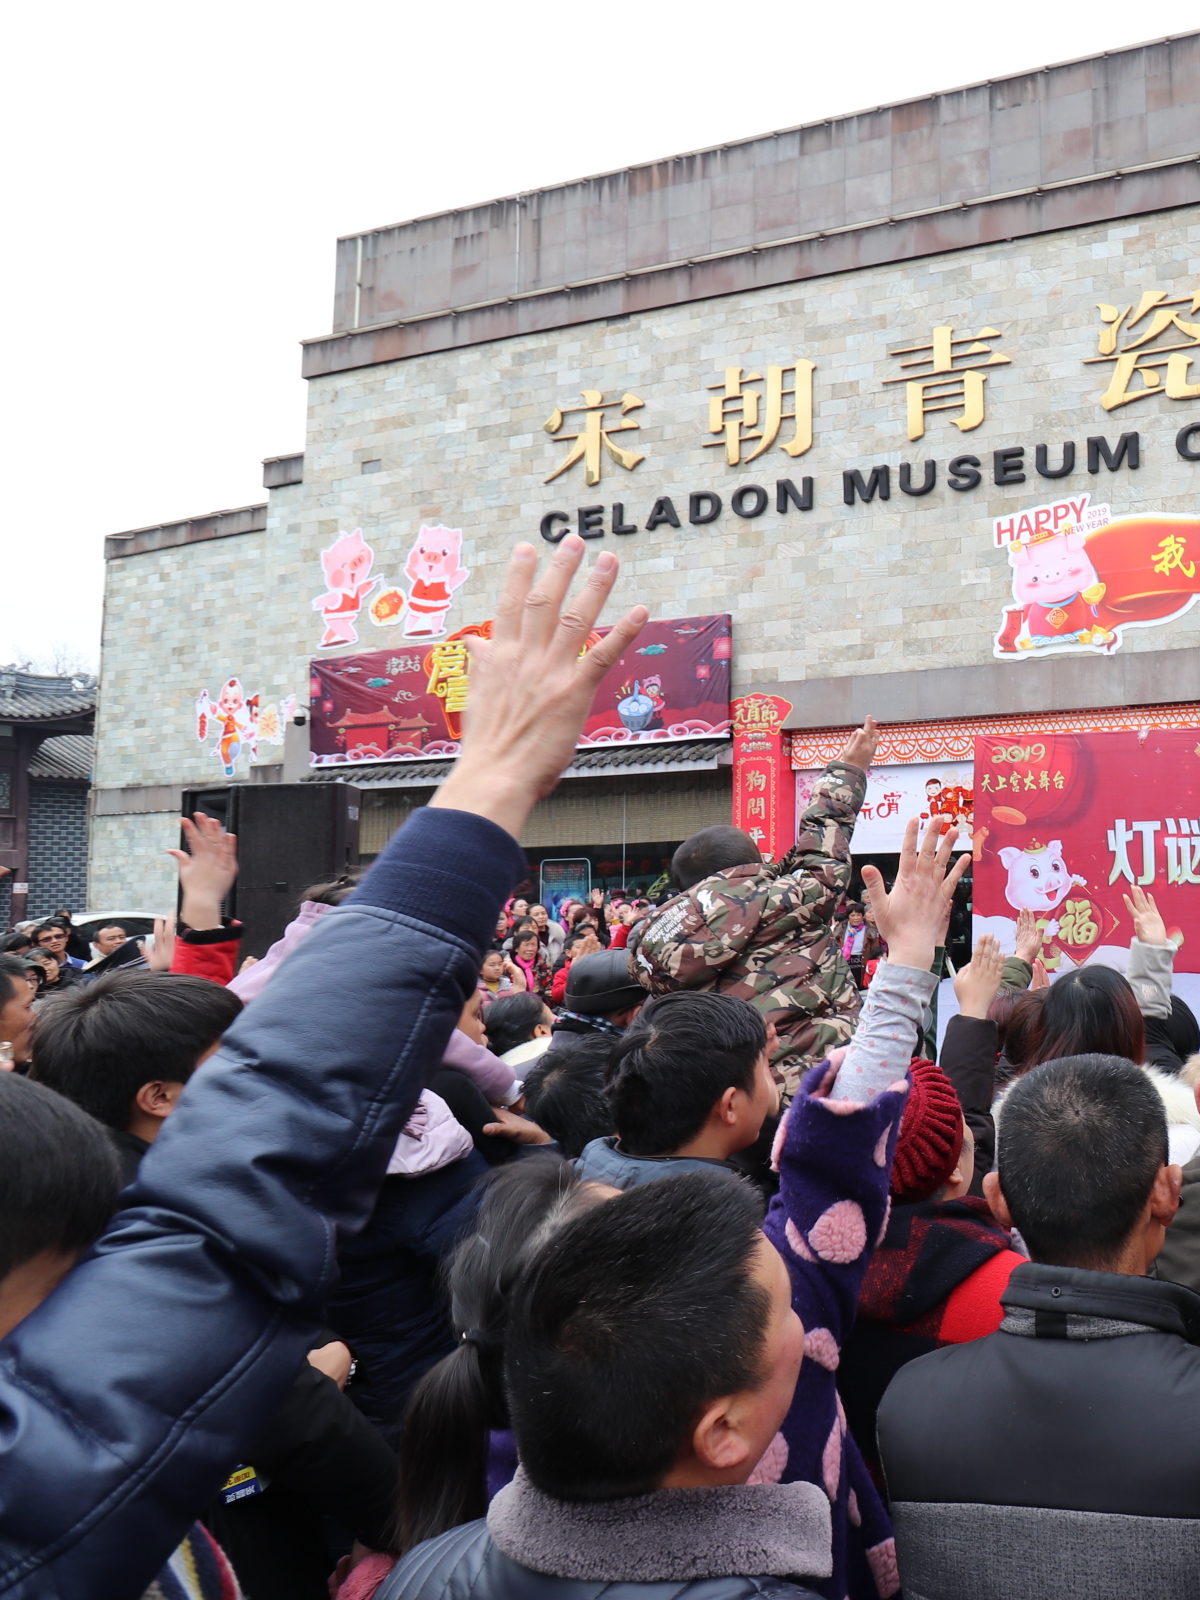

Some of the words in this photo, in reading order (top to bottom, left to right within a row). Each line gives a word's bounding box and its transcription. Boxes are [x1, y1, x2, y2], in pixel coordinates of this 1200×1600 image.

[540, 475, 814, 543] CELADON
[843, 430, 1140, 506] MUSEUM
[996, 498, 1088, 546] HAPPY
[1087, 507, 1107, 520] 2019
[1064, 523, 1085, 536] NEW
[1085, 517, 1109, 532] YEAR
[1057, 899, 1099, 945] 福
